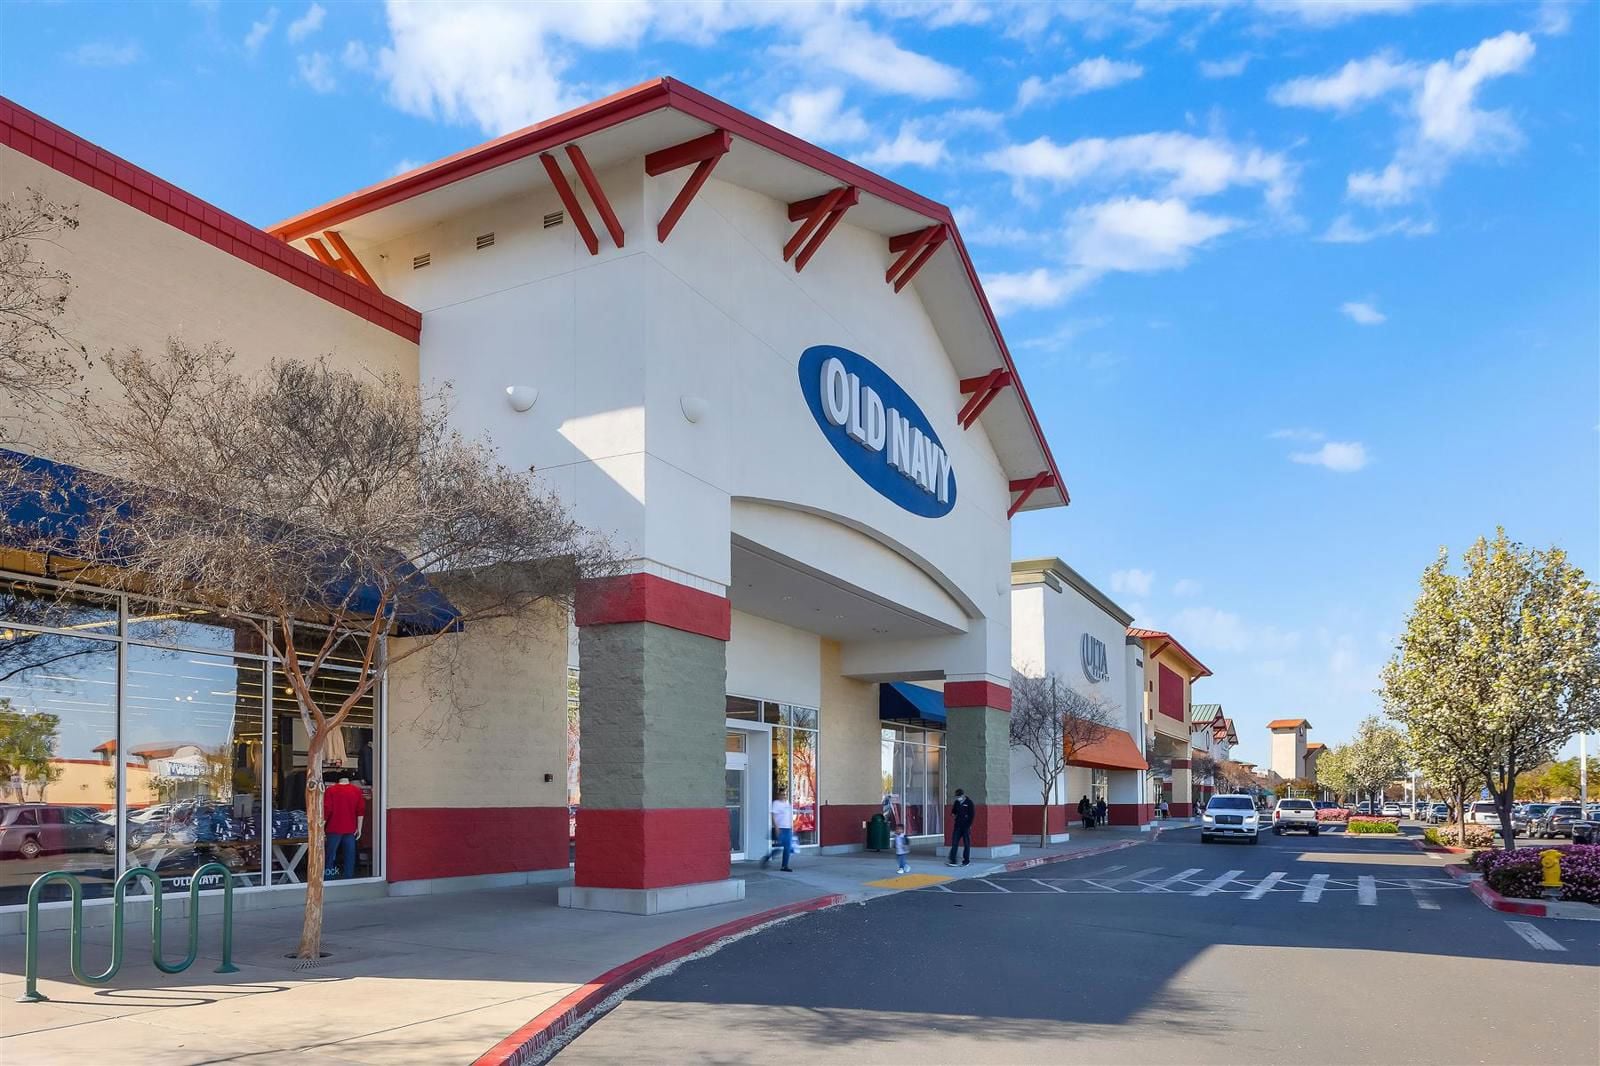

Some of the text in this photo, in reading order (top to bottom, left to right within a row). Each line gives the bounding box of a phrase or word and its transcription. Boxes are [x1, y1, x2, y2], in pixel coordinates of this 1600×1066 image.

[820, 357, 951, 504] OLD NAVY
[1083, 632, 1108, 677] ULTA
